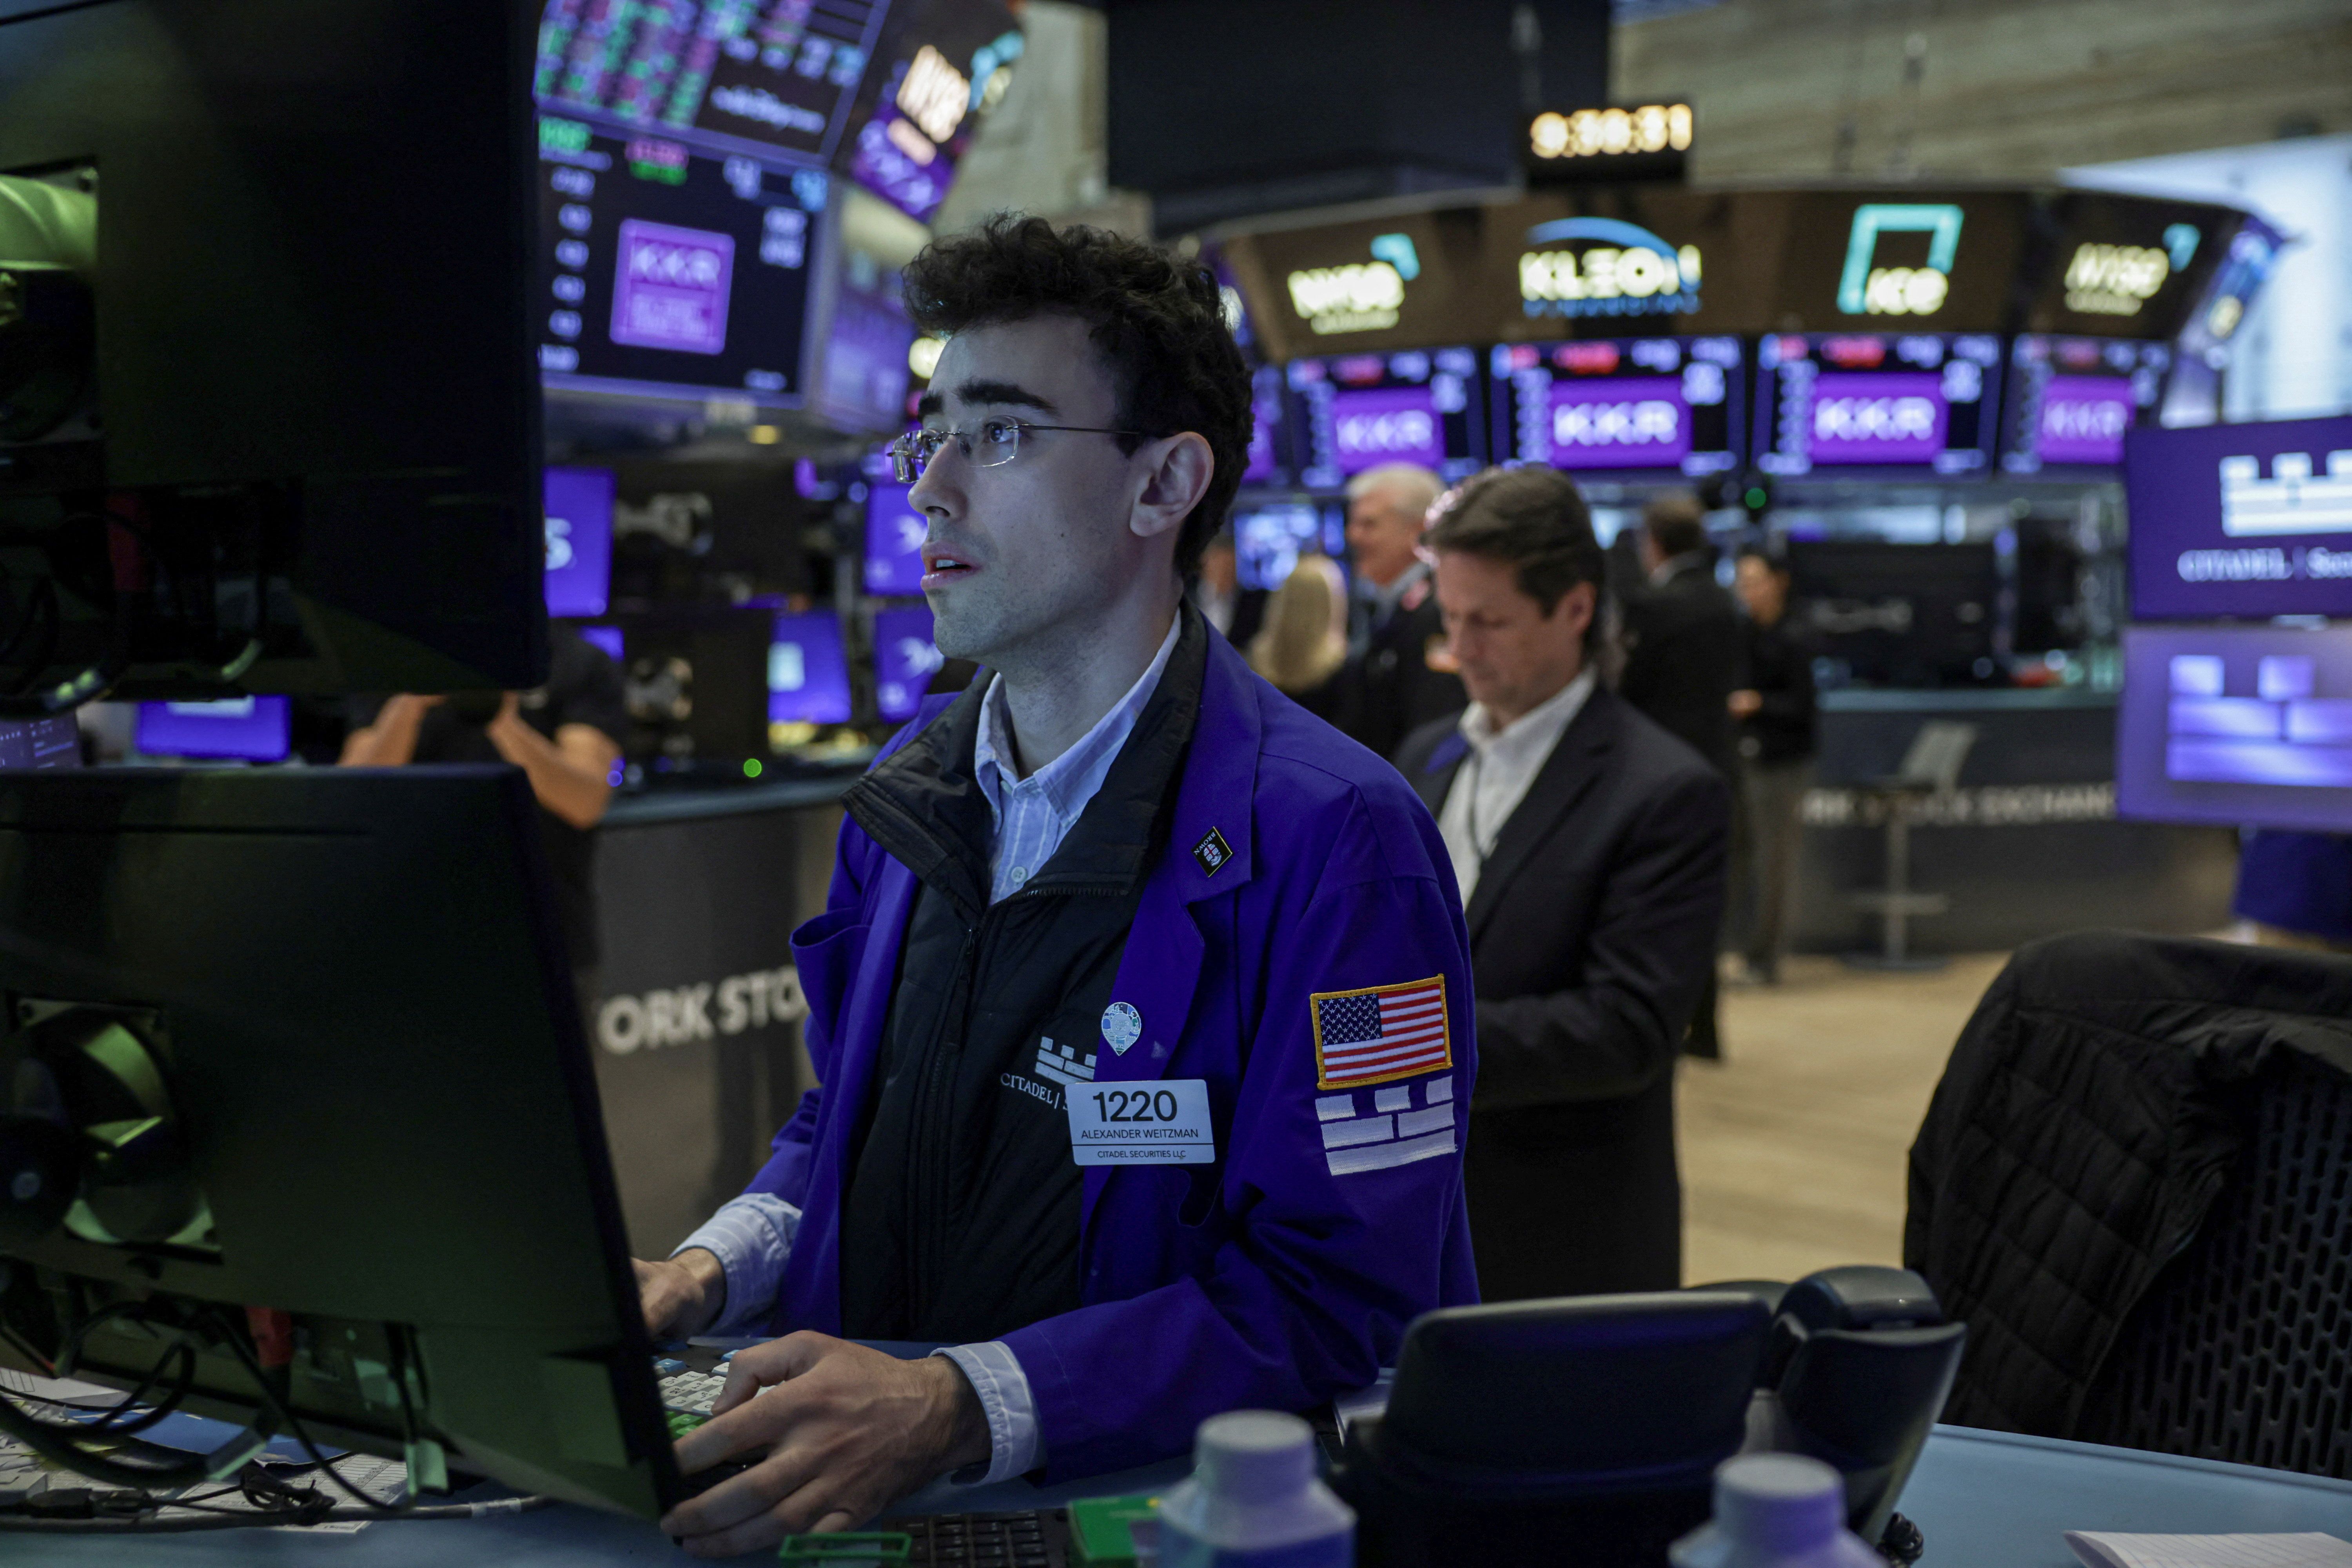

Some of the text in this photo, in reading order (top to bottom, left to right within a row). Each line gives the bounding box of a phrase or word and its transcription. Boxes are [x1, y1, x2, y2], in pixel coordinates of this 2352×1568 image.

[1194, 832, 1216, 855] BROWN
[1001, 1073, 1053, 1104] CITADEL
[1093, 1090, 1177, 1122] 1220
[1082, 1129, 1198, 1139] ALEXANDER WEITZMAN
